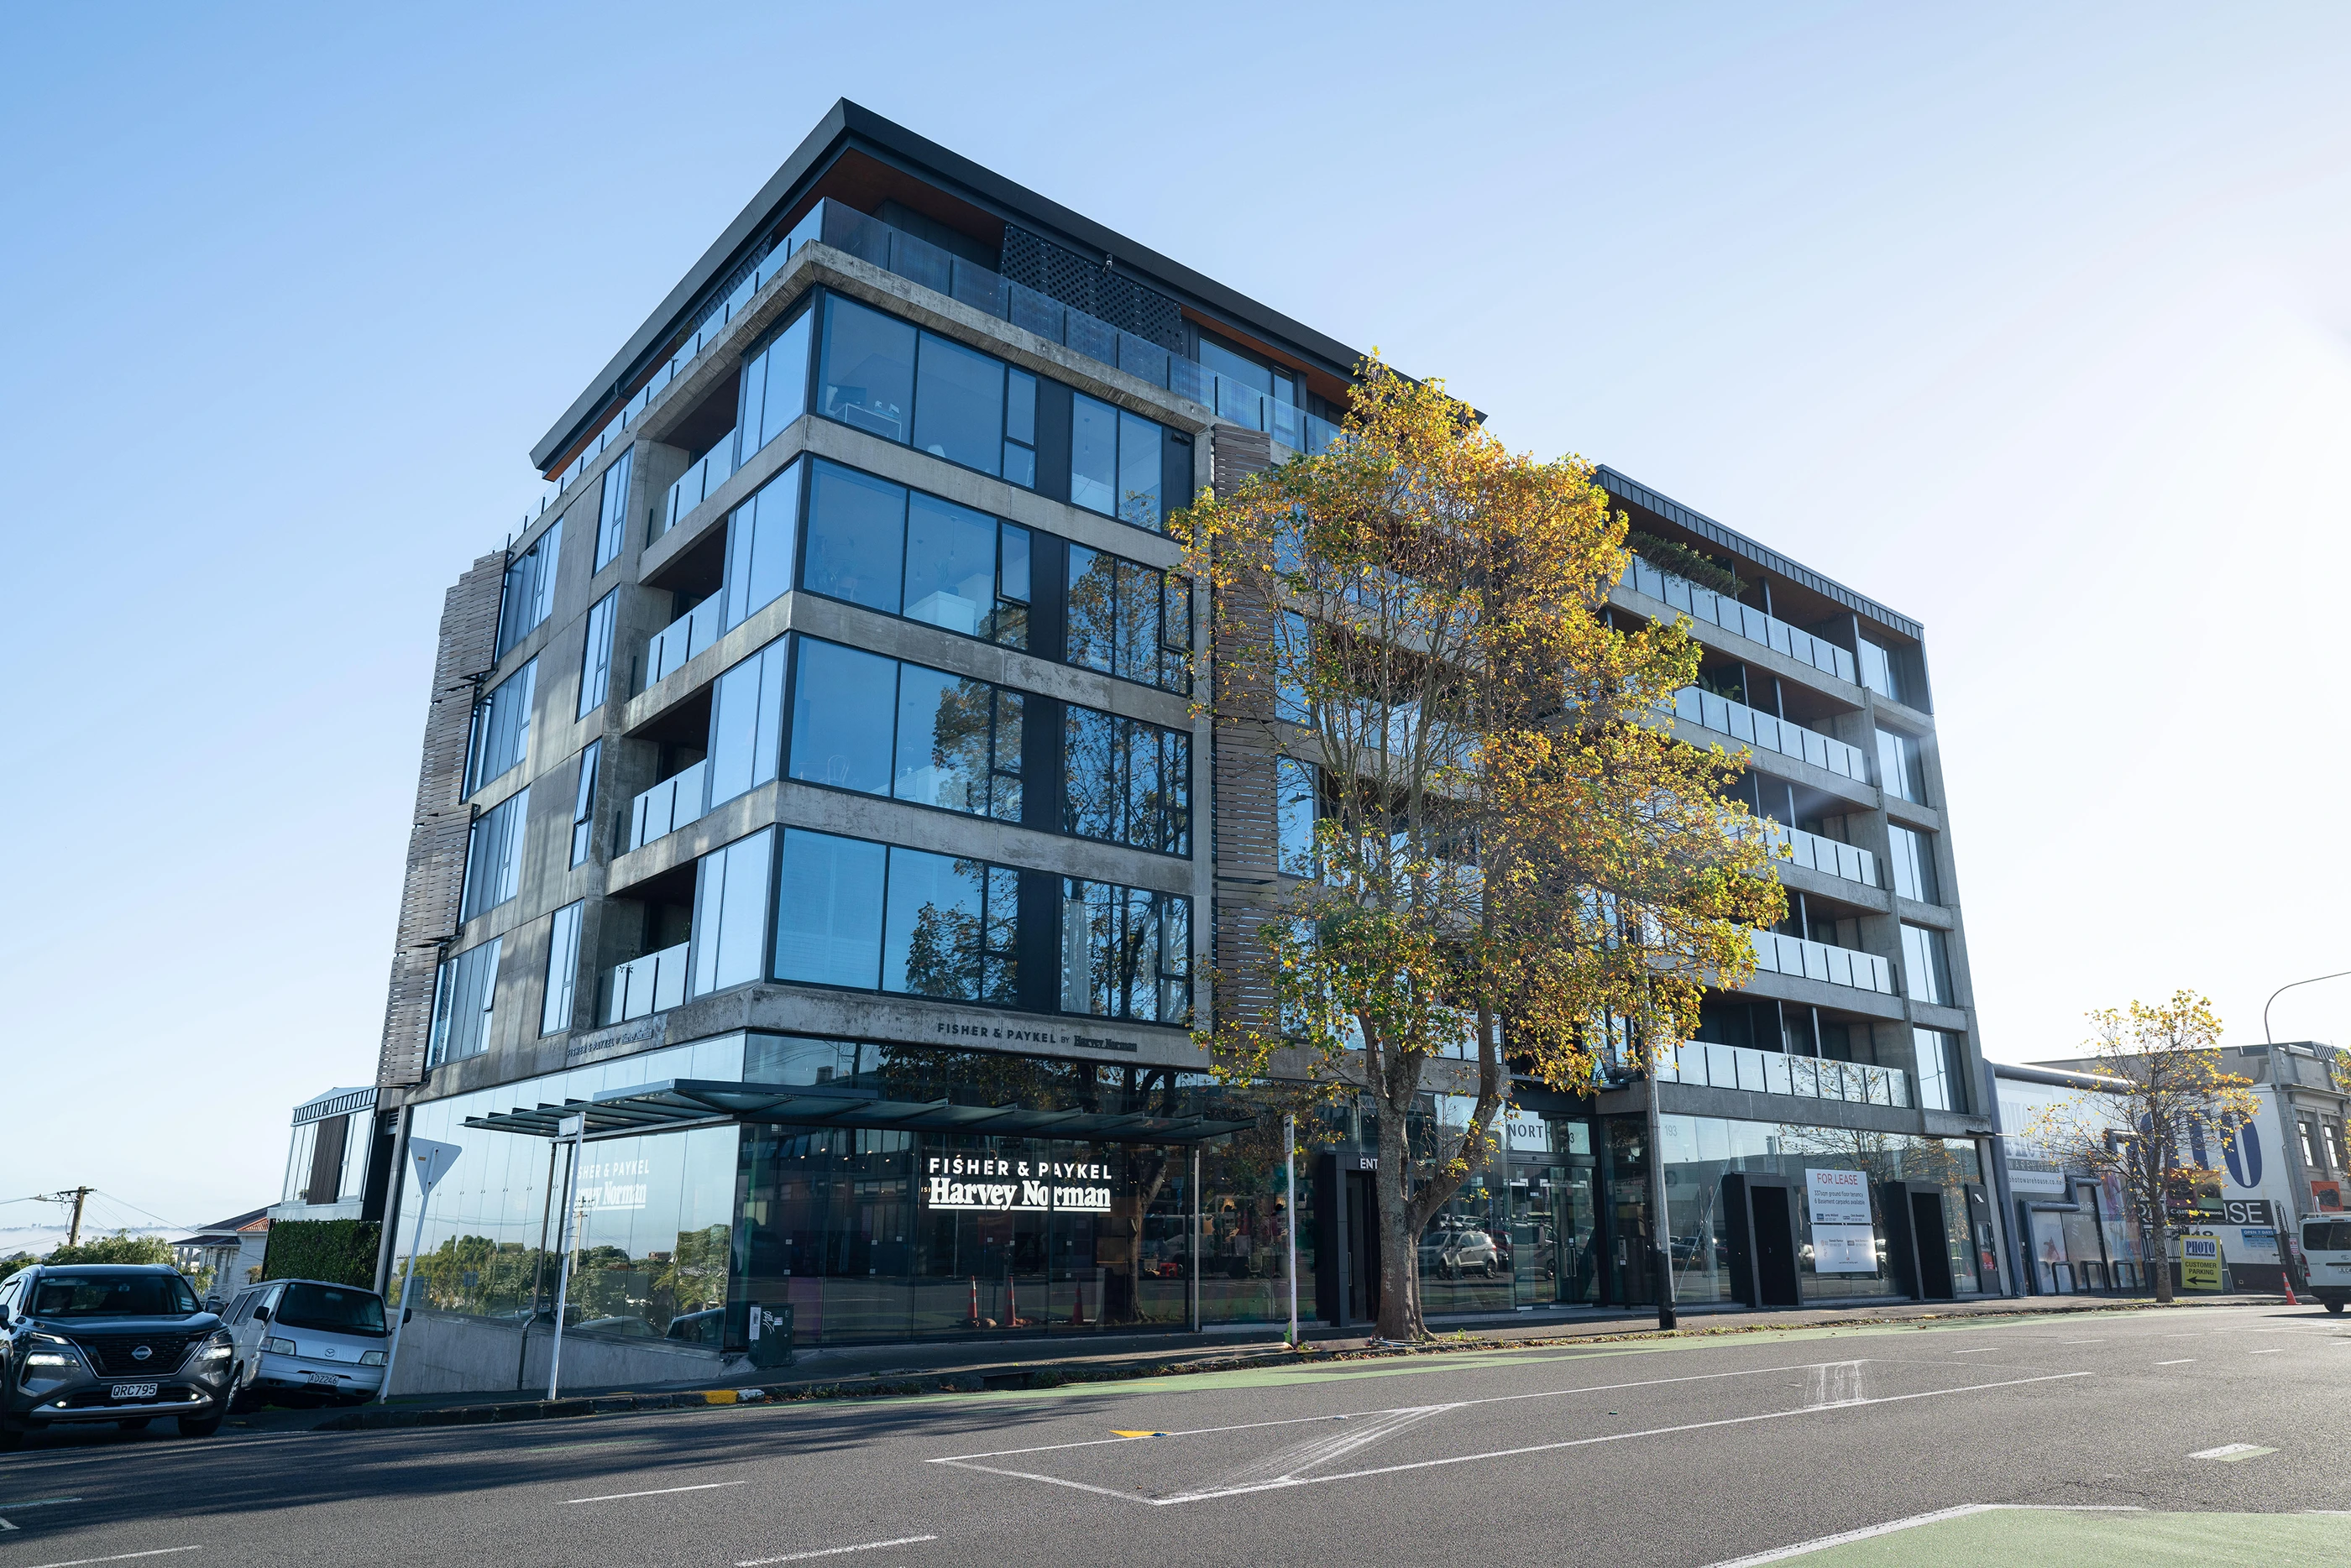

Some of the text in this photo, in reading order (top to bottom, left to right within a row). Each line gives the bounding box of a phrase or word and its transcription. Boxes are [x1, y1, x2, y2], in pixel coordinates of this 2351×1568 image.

[938, 1022, 988, 1037] FISHER
[993, 1027, 1003, 1038] &
[1008, 1032, 1056, 1043] PAYKEL
[1074, 1035, 1104, 1049] Harvey
[1105, 1038, 1138, 1053] Norman
[1665, 1125, 1678, 1137] 193
[604, 1163, 610, 1177] &
[613, 1159, 649, 1177] PAYKEL
[929, 1158, 1112, 1179] FISHER & PAYKEL
[1816, 1173, 1858, 1185] FOR LEASE
[602, 1180, 647, 1205] Norman
[929, 1177, 1111, 1210] Harvey Norman
[2186, 1241, 2215, 1254] PHOTO
[2185, 1261, 2217, 1269] CUSTOMER
[309, 1374, 338, 1385] ADZ246
[113, 1385, 157, 1397] QRC795
